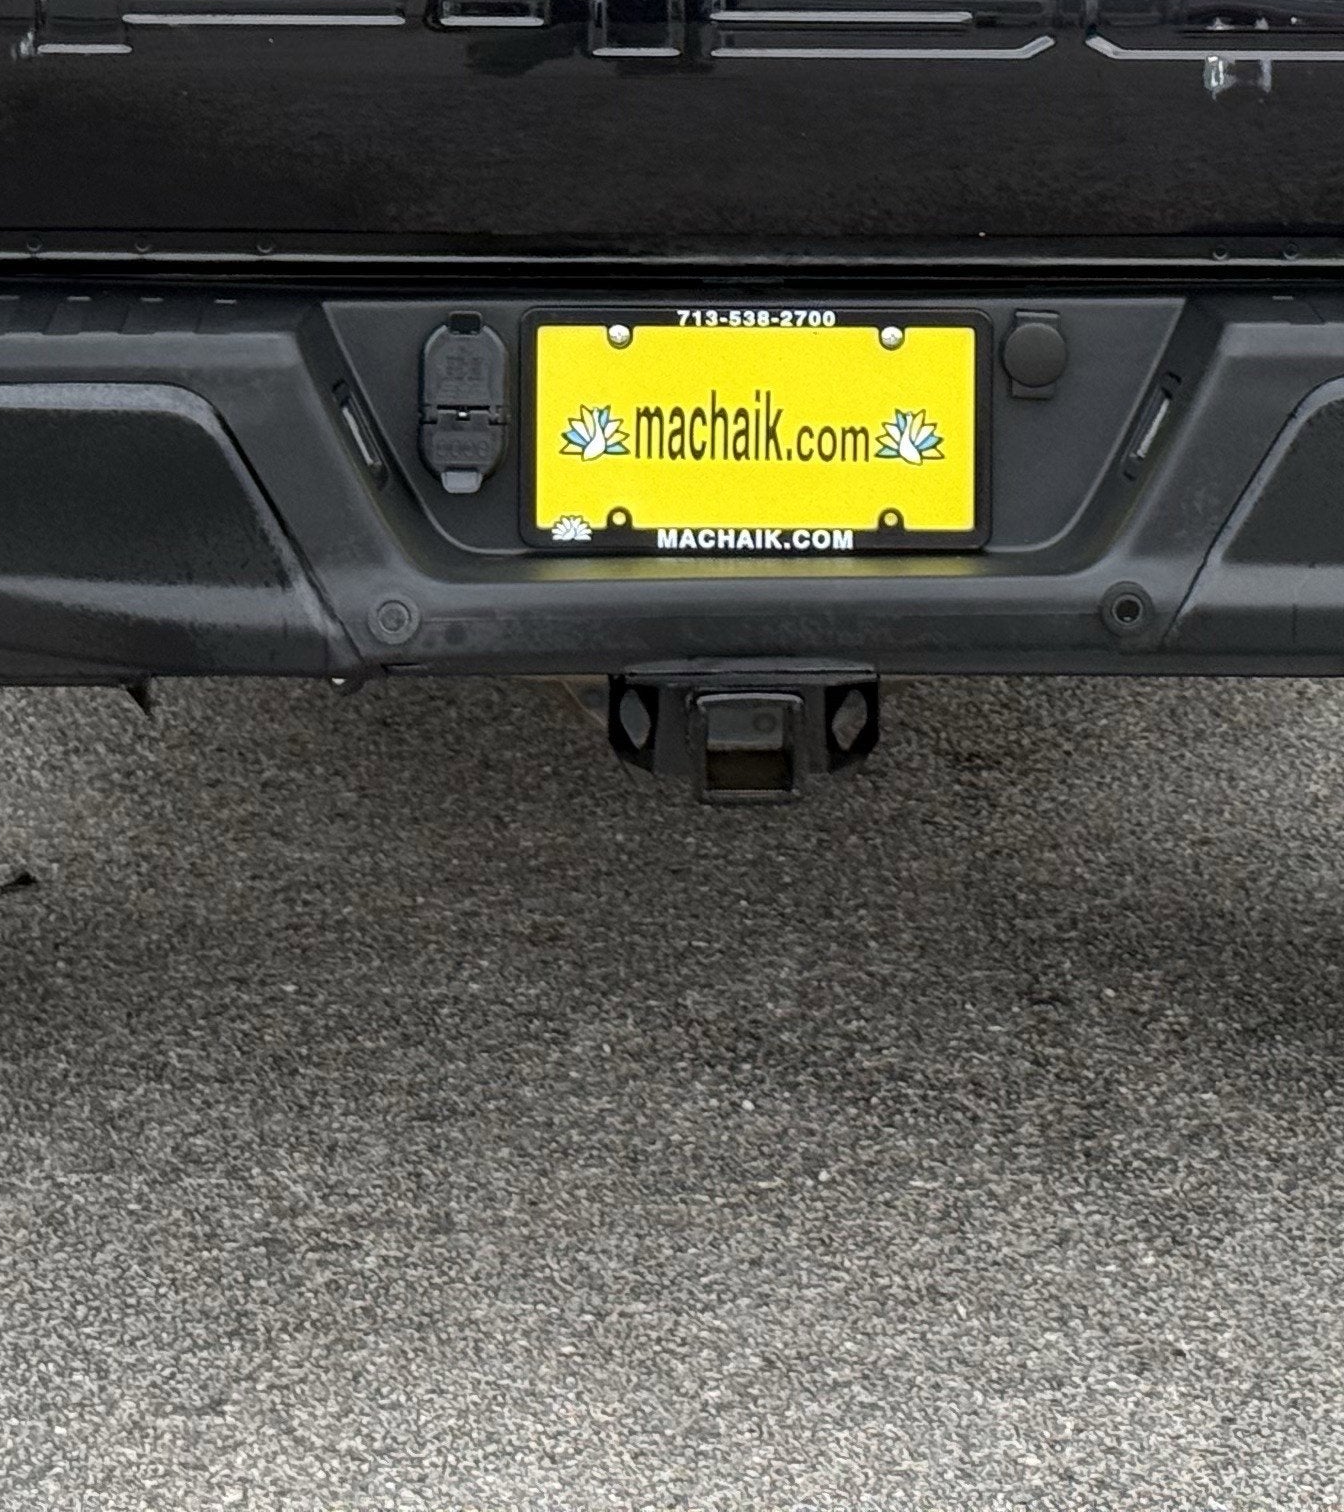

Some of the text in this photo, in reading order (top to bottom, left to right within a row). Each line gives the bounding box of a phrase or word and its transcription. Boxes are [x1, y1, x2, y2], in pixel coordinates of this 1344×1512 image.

[676, 309, 837, 328] 713-538-2700
[635, 389, 870, 463] machaik.com
[656, 528, 854, 551] MACHAIK.COM
